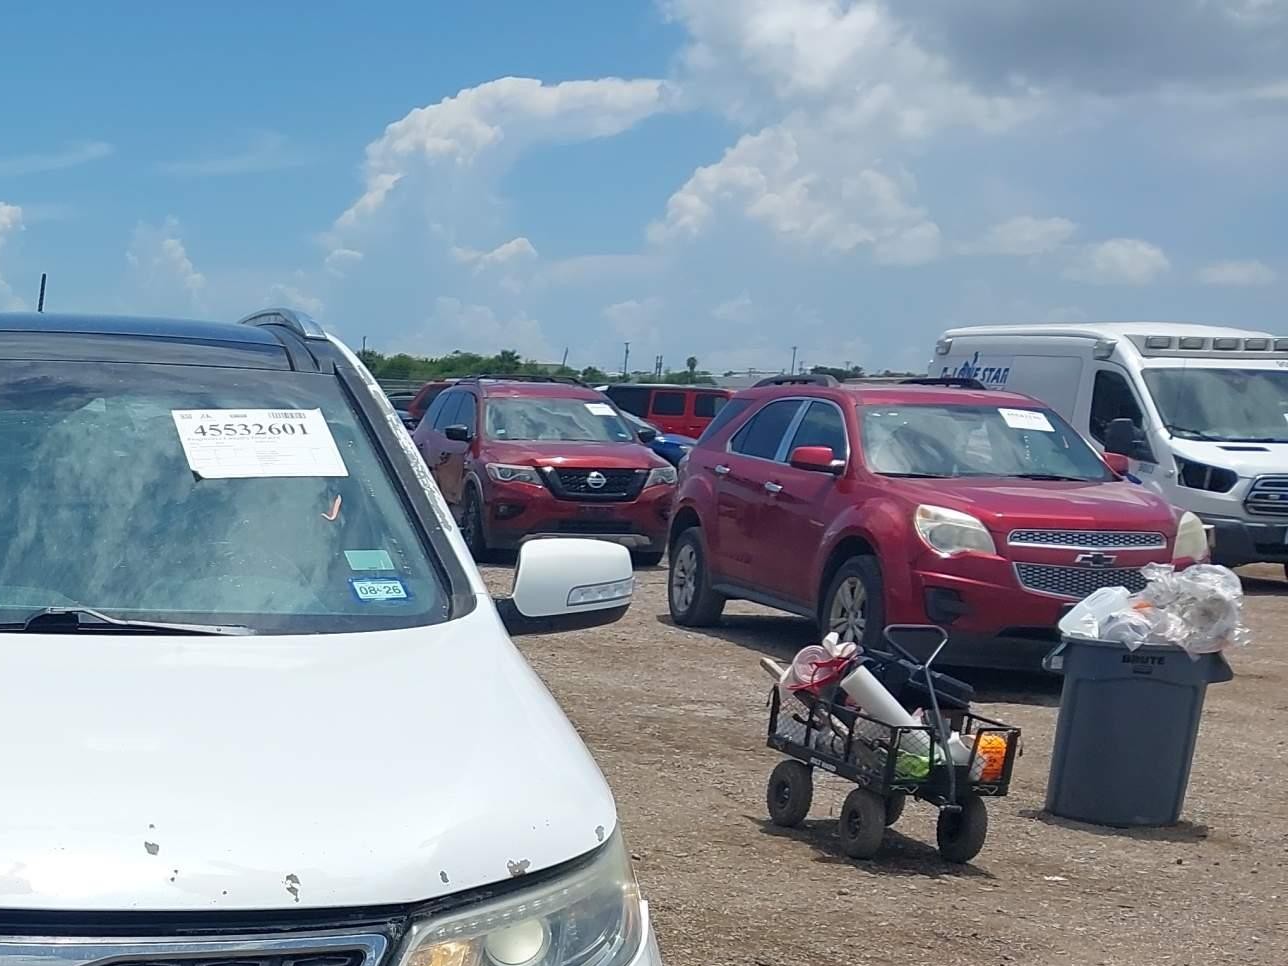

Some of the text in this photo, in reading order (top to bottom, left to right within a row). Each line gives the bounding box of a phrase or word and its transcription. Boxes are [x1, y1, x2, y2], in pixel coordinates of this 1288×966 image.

[980, 367, 1010, 384] STAR
[194, 423, 310, 436] 45532601
[1122, 655, 1165, 665] BRUTE
